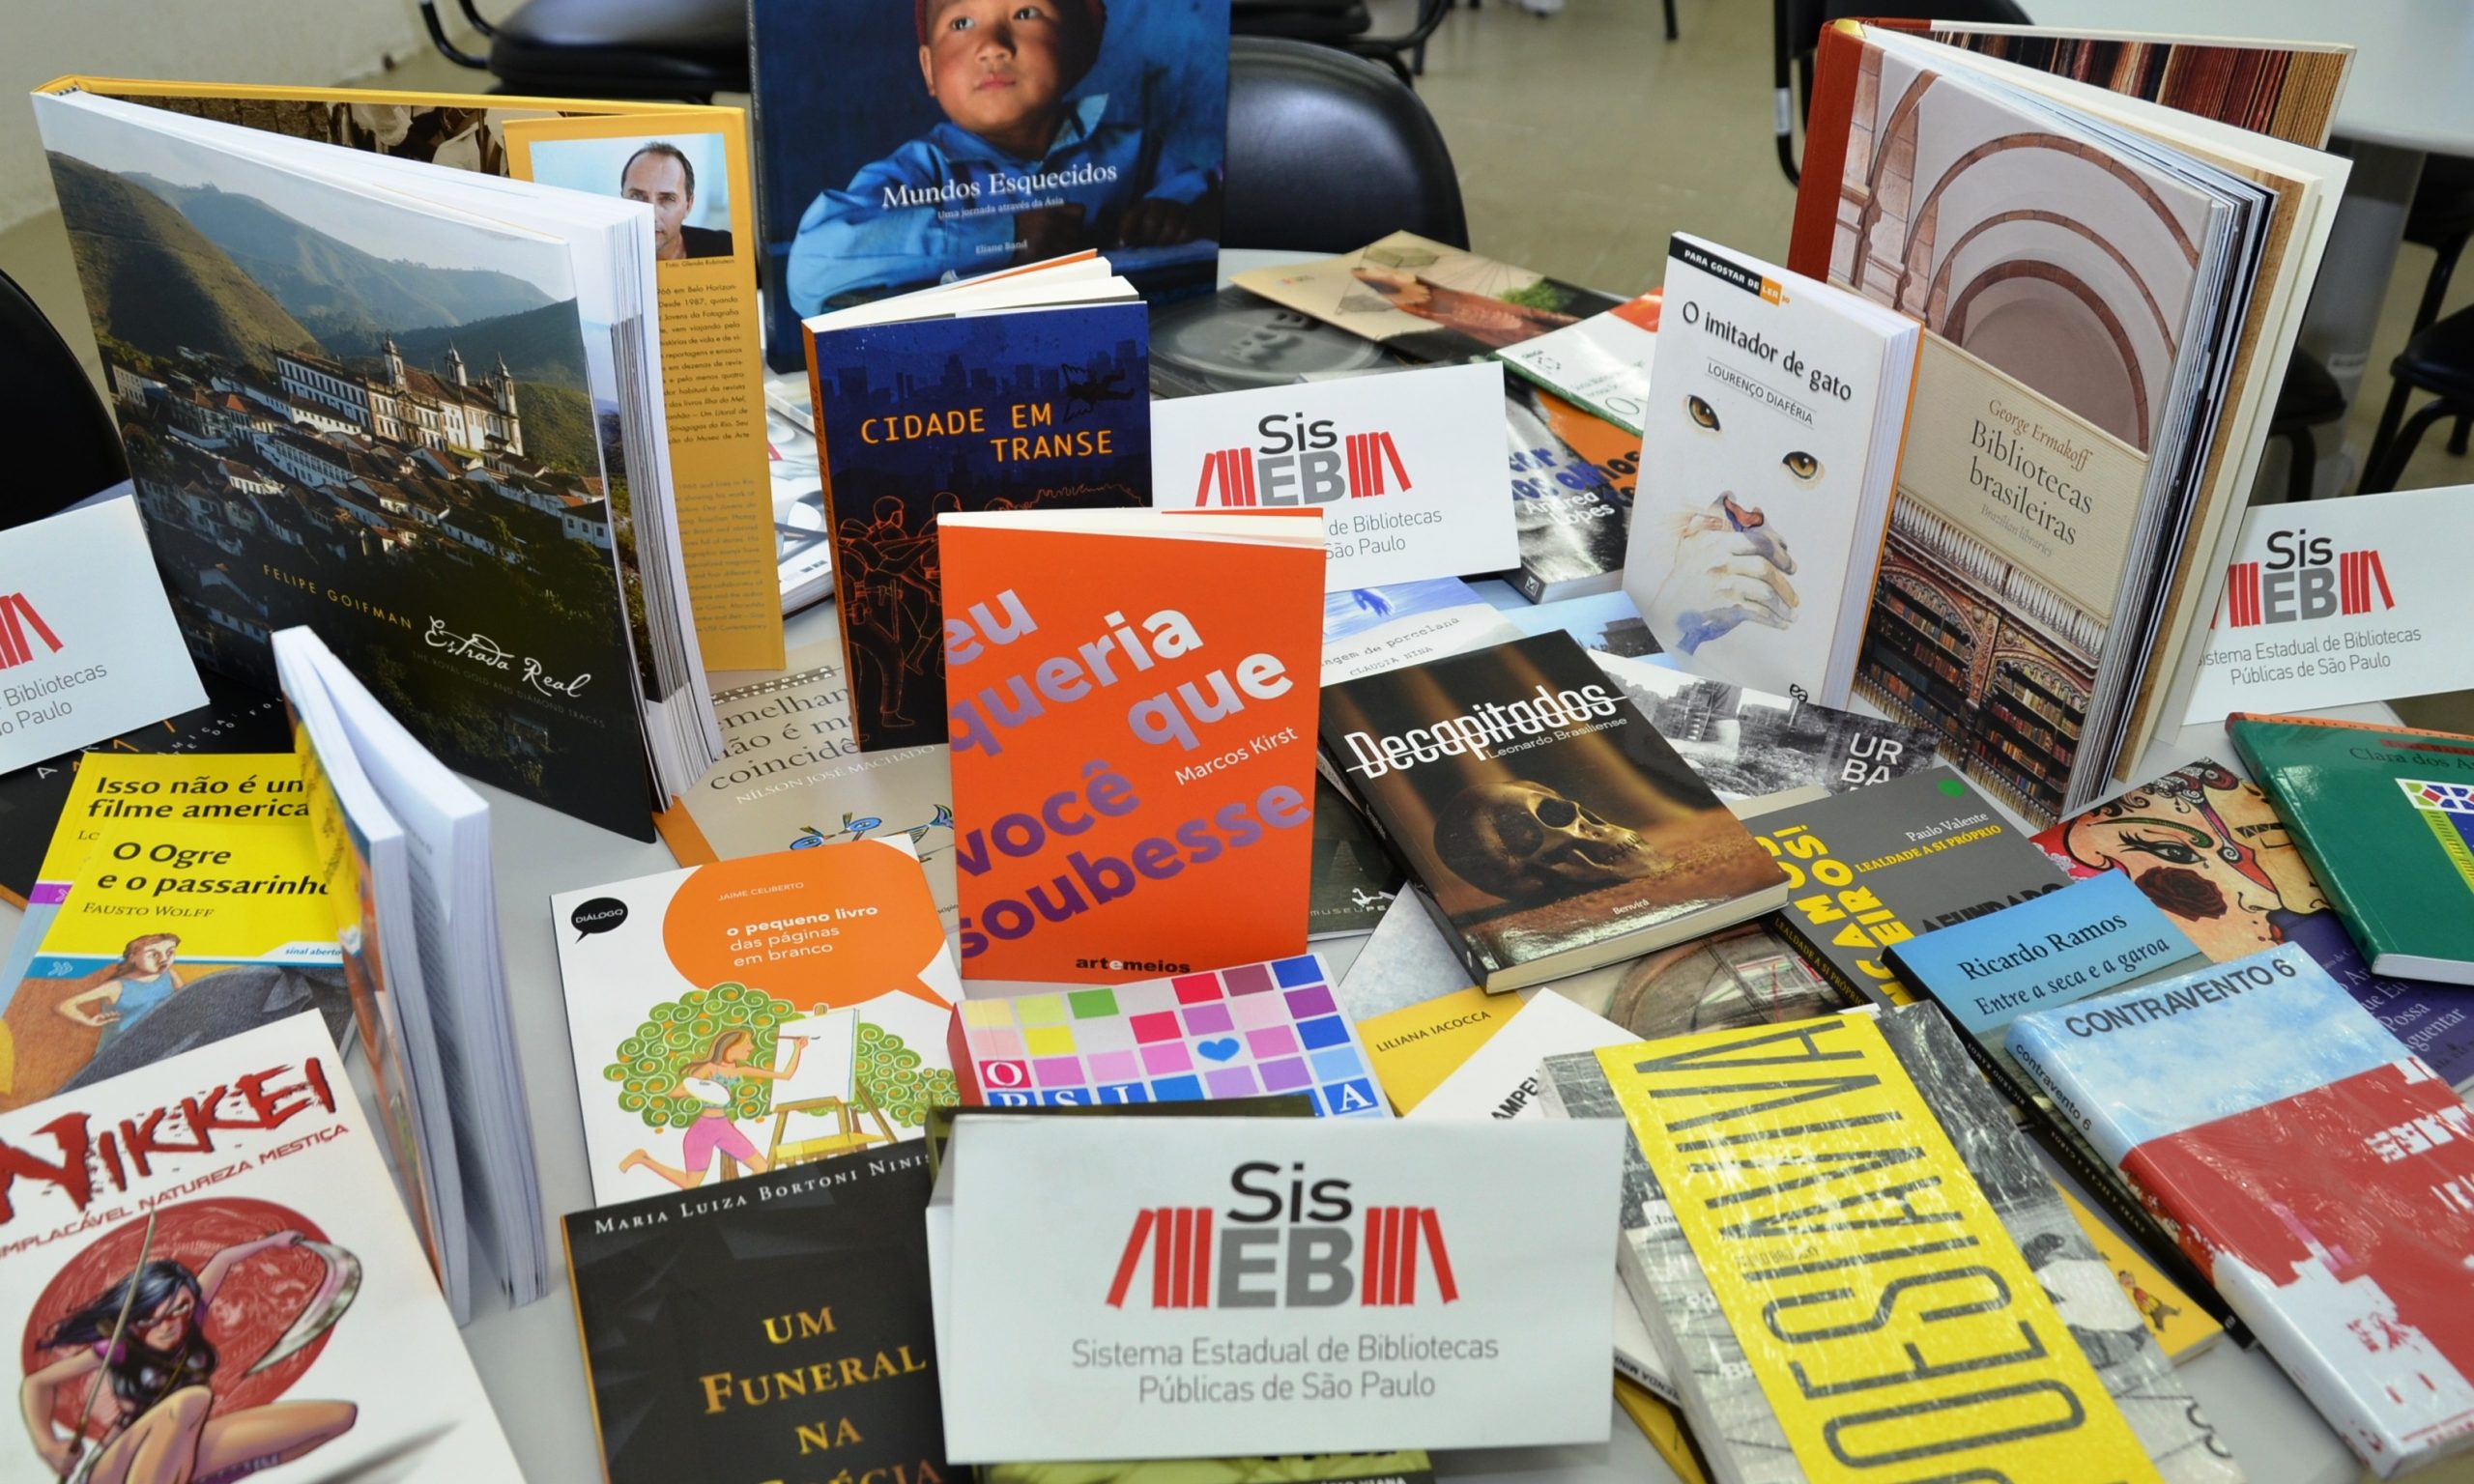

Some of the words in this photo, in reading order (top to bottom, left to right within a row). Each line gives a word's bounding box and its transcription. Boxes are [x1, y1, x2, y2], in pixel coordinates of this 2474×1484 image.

[881, 175, 982, 211] Mundos
[988, 162, 1118, 196] Esquecidos
[937, 207, 960, 220] Uma
[962, 203, 996, 220] jornada
[997, 201, 1032, 216] através
[1033, 199, 1044, 210] da
[975, 242, 1004, 255] Eliane
[1005, 239, 1028, 251] Band
[705, 283, 736, 292] Horizon-
[1684, 249, 1708, 268] PARA
[1711, 262, 1745, 283] GOSTAR
[1747, 279, 1760, 290] DE
[1762, 285, 1779, 298] LER
[703, 309, 739, 320] Fotografia
[710, 297, 738, 306] quando
[690, 323, 721, 334] viajando
[666, 349, 708, 359] reportagens
[715, 346, 742, 355] ensaios
[681, 361, 711, 370] dezenas
[1683, 300, 1699, 324] O
[1704, 310, 1778, 365] imitador
[1783, 349, 1804, 378] de
[1808, 365, 1852, 402] gato
[721, 371, 744, 382] quatro
[722, 383, 745, 391] revista
[1707, 360, 1765, 401] LOURENÇO
[1765, 386, 1814, 426] DIAFÉRIA
[697, 433, 719, 442] Museu
[860, 408, 985, 444] CIDADE
[1012, 403, 1052, 430] EM
[1257, 411, 1338, 455] Sis
[1988, 398, 2030, 435] George
[2029, 419, 2094, 471] Ermakoff
[991, 430, 1113, 463] TRANSE
[1257, 451, 1346, 507] EB
[1970, 419, 2093, 515] Bibliotecas
[1523, 491, 1600, 515] Andrea
[1549, 502, 1616, 526] Lopes
[1970, 456, 2077, 546] brasileiras
[1329, 519, 1348, 536] de
[1353, 510, 1443, 533] Bibliotecas
[1981, 503, 2021, 543] Brazilian
[2019, 523, 2055, 558] libraries
[1359, 535, 1406, 556] Paulo
[2265, 528, 2333, 570] Sis
[263, 563, 317, 595] FELIPE
[326, 588, 414, 630] GOIFMAN
[2262, 567, 2338, 625] EB
[944, 588, 1039, 667] eu
[1365, 645, 1383, 655] de
[1386, 615, 1460, 648] porcelana
[2256, 635, 2317, 661] Estadual
[2321, 635, 2341, 653] de
[2345, 626, 2422, 651] Bibliotecas
[424, 614, 515, 671] Estrada
[522, 657, 591, 698] Real
[1349, 656, 1399, 677] CLAUDIA
[1403, 645, 1434, 661] NINA
[2230, 658, 2293, 685] Públicas
[2296, 660, 2316, 678] de
[2317, 654, 2347, 676] São
[2350, 652, 2392, 673] Paulo
[4, 661, 108, 707] Bibliotecas
[710, 673, 807, 699] VIVENDO
[713, 671, 833, 706] MATEMÁTICA
[949, 608, 1205, 757] queria
[15, 699, 73, 730] Paulo
[1127, 651, 1294, 753] que
[784, 724, 802, 741] é
[1345, 684, 1617, 780] Decapitados
[1485, 731, 1553, 759] Leonardo
[1555, 716, 1628, 741] Brasiliense
[1850, 731, 1903, 765] UR
[1174, 743, 1250, 786] Marcos
[1249, 725, 1298, 756] Kirst
[2349, 746, 2407, 764] Clara
[2412, 751, 2451, 767] dos
[96, 777, 160, 794] Isso
[170, 776, 229, 794] não
[238, 775, 256, 793] é
[735, 777, 804, 805] NÍLSON
[806, 766, 846, 786] JOSÉ
[848, 745, 935, 774] MACHADO
[88, 799, 173, 817] filme
[956, 757, 1141, 878] você
[1905, 823, 1940, 843] Paulo
[1941, 812, 1990, 836] Valente
[113, 842, 141, 860] O
[149, 843, 232, 870] Ogre
[1855, 846, 1923, 874] LEALDADE
[1923, 843, 1933, 855] A
[1934, 840, 1945, 853] SI
[1944, 823, 2002, 850] PRÓPRIO
[97, 874, 118, 889] e
[126, 876, 147, 890] o
[961, 784, 1312, 959] soubesse
[718, 888, 749, 901] JAIME
[750, 881, 805, 897] CELIBERTO
[1611, 896, 1651, 917] Benvirá
[82, 901, 150, 917] FAUSTO
[155, 904, 215, 919] WOLFF
[574, 907, 624, 925] DIÁLOGO
[726, 925, 739, 937] o
[745, 910, 831, 937] pequeno
[834, 903, 879, 921] livro
[285, 946, 309, 956] sinal
[310, 947, 342, 956] aberto
[730, 936, 763, 953] das
[767, 925, 841, 949] páginas
[733, 954, 763, 968] em
[767, 941, 834, 962] branco
[1774, 918, 1816, 960] LEALDADE
[1958, 935, 2048, 983] Ricardo
[2052, 910, 2128, 954] Ramos
[1075, 956, 1192, 975] artemeios
[1973, 981, 2029, 1017] Entre
[2031, 978, 2045, 994] a
[2047, 965, 2086, 994] seca
[2087, 961, 2100, 976] e
[2103, 955, 2117, 971] a
[2119, 936, 2171, 972] garoa
[2064, 957, 2275, 1039] CONTRAVENTO
[2272, 956, 2297, 978] 6
[1375, 1025, 1431, 1053] LILIANA
[1430, 1010, 1492, 1039] IACOCCA
[2378, 1002, 2431, 1032] Possa
[1992, 1069, 2027, 1106] RICARDO
[2015, 1042, 2082, 1121] contravento
[2082, 1118, 2093, 1132] 6
[0, 1056, 336, 1226] NIKKEI
[138, 1158, 253, 1210] NATUREZA
[258, 1123, 350, 1165] MESTIÇA
[594, 1211, 669, 1235] MARIA
[679, 1194, 748, 1219] LUIZA
[758, 1170, 859, 1202] BORTONI
[1225, 1160, 1353, 1224] Sis
[1217, 1226, 1354, 1309] EB
[762, 1305, 837, 1345] UM
[1070, 1336, 1182, 1368] Sistema
[1192, 1335, 1309, 1365] Estadual
[1316, 1334, 1349, 1363] de
[1358, 1332, 1499, 1361] Bibliotecas
[699, 1344, 928, 1414] FUNERAL
[1138, 1369, 1255, 1404] Públicas
[1261, 1372, 1294, 1401] de
[1301, 1370, 1353, 1400] São
[1361, 1369, 1436, 1399] Paulo
[794, 1416, 863, 1456] NA
